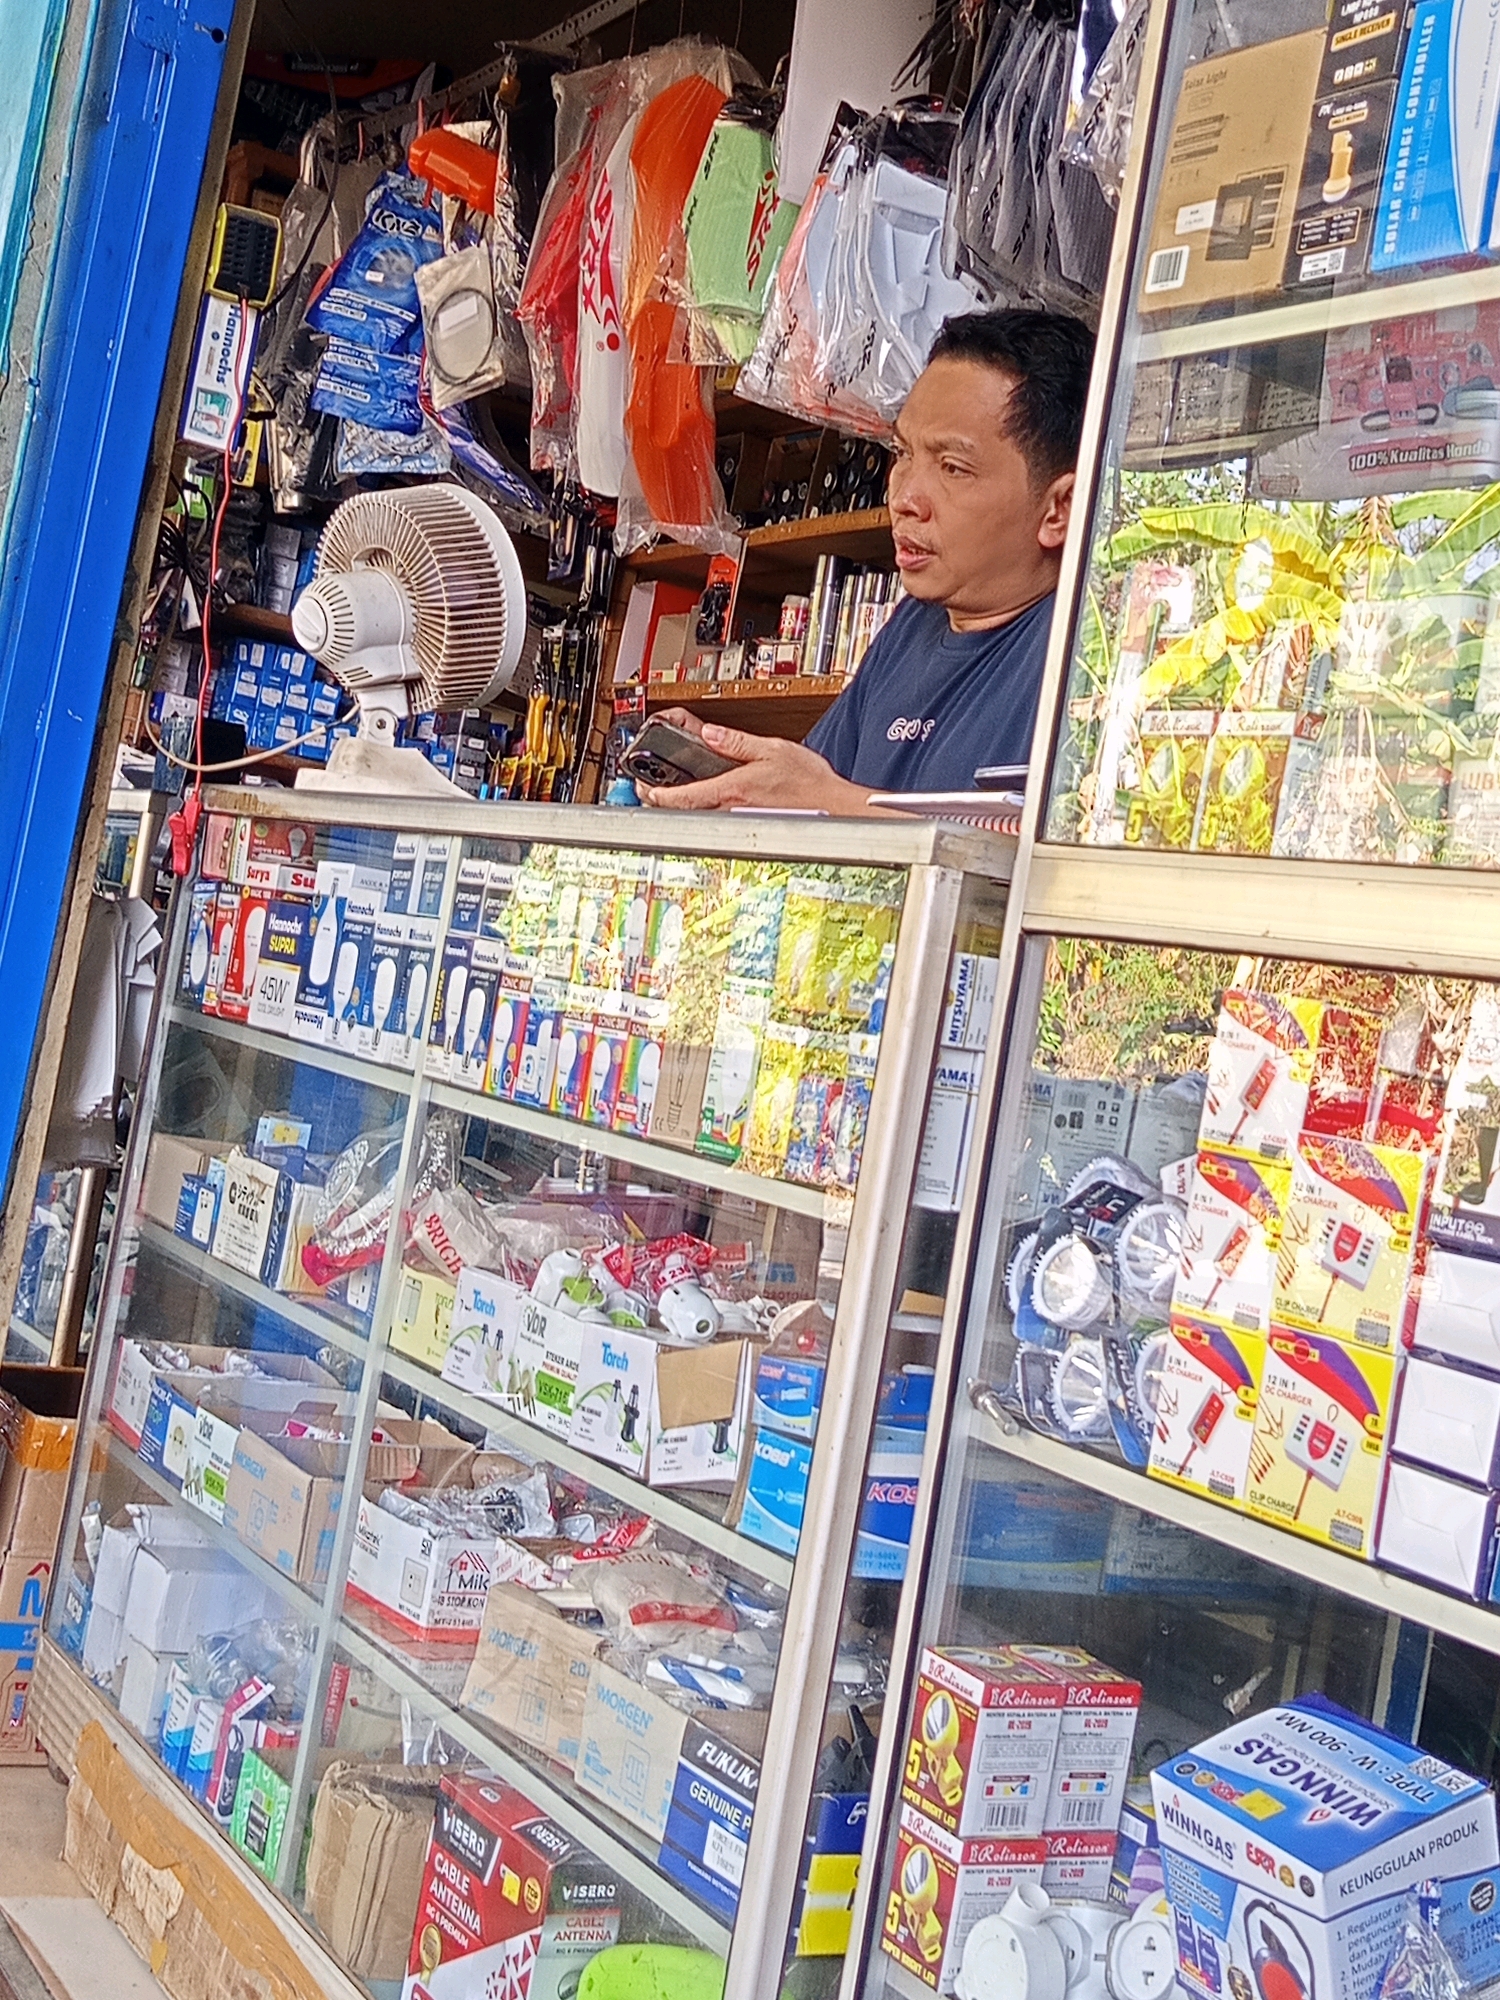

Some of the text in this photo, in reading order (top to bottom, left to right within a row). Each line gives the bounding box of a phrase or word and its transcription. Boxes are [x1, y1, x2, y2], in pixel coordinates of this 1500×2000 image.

[1334, 27, 1360, 47] SINGLE
[1206, 70, 1228, 85] Light
[1384, 198, 1402, 254] SOLAR
[1393, 125, 1414, 193] CHARGE
[1405, 14, 1436, 120] CONTROLLER
[216, 304, 241, 387] Hannochs
[247, 866, 270, 883] Surya
[461, 868, 484, 880] Hannochs
[348, 900, 375, 916] Hannochs
[268, 913, 302, 935] Hannochs
[377, 923, 402, 938] Hannochs
[269, 935, 296, 955] SUPRA
[473, 950, 499, 965] Hannochs
[260, 975, 288, 1004] 45W
[501, 976, 517, 989] SONIC
[948, 957, 970, 1044] MITSUYAMA
[295, 1010, 323, 1029] Hannochs
[1306, 1185, 1316, 1195] IN
[1202, 1205, 1229, 1218] CHARGER
[1304, 1196, 1338, 1211] CHARGER
[473, 1289, 497, 1317] Torch
[1275, 1298, 1290, 1310] CLIP
[527, 1306, 547, 1338] VDR
[602, 1341, 629, 1372] Torch
[1166, 1366, 1203, 1383] DC CHARGER
[1267, 1374, 1277, 1386] 12
[1279, 1378, 1289, 1389] IN
[1265, 1385, 1312, 1406] DC CHARGER
[1153, 1453, 1165, 1464] CLIP
[1250, 1490, 1265, 1503] CLIP
[488, 1627, 540, 1661] MORGEN
[598, 1684, 653, 1730] MORGEN
[1000, 1688, 1056, 1706] Rolinson
[1076, 1687, 1133, 1705] Rolinson
[1276, 1712, 1310, 1734] NM
[1310, 1729, 1347, 1753] 900
[906, 1739, 922, 1782] 5
[1353, 1753, 1377, 1771] W
[1234, 1738, 1382, 1827] WINNGAS
[1385, 1771, 1435, 1803] TYPE
[689, 1781, 744, 1825] GENUINE
[443, 1807, 486, 1857] VISERO
[527, 1824, 571, 1855] VISERO
[1161, 1801, 1234, 1860] WINNGAS
[978, 1845, 1036, 1863] Rolinson
[1051, 1838, 1108, 1855] Rolinson
[1339, 1819, 1480, 1897] KEUNGGULAN PRODUK
[434, 1852, 470, 1896] CABLE
[563, 1884, 616, 1901] VISERO
[429, 1877, 481, 1936] ANTENNA
[885, 1890, 902, 1936] 5
[439, 1915, 469, 1950] PREMIUM
[1347, 1906, 1392, 1937] Regulator
[554, 1930, 612, 1942] ANTENNA
[1349, 1936, 1394, 1964] dan karet
[1351, 1954, 1386, 1976] Mudah
